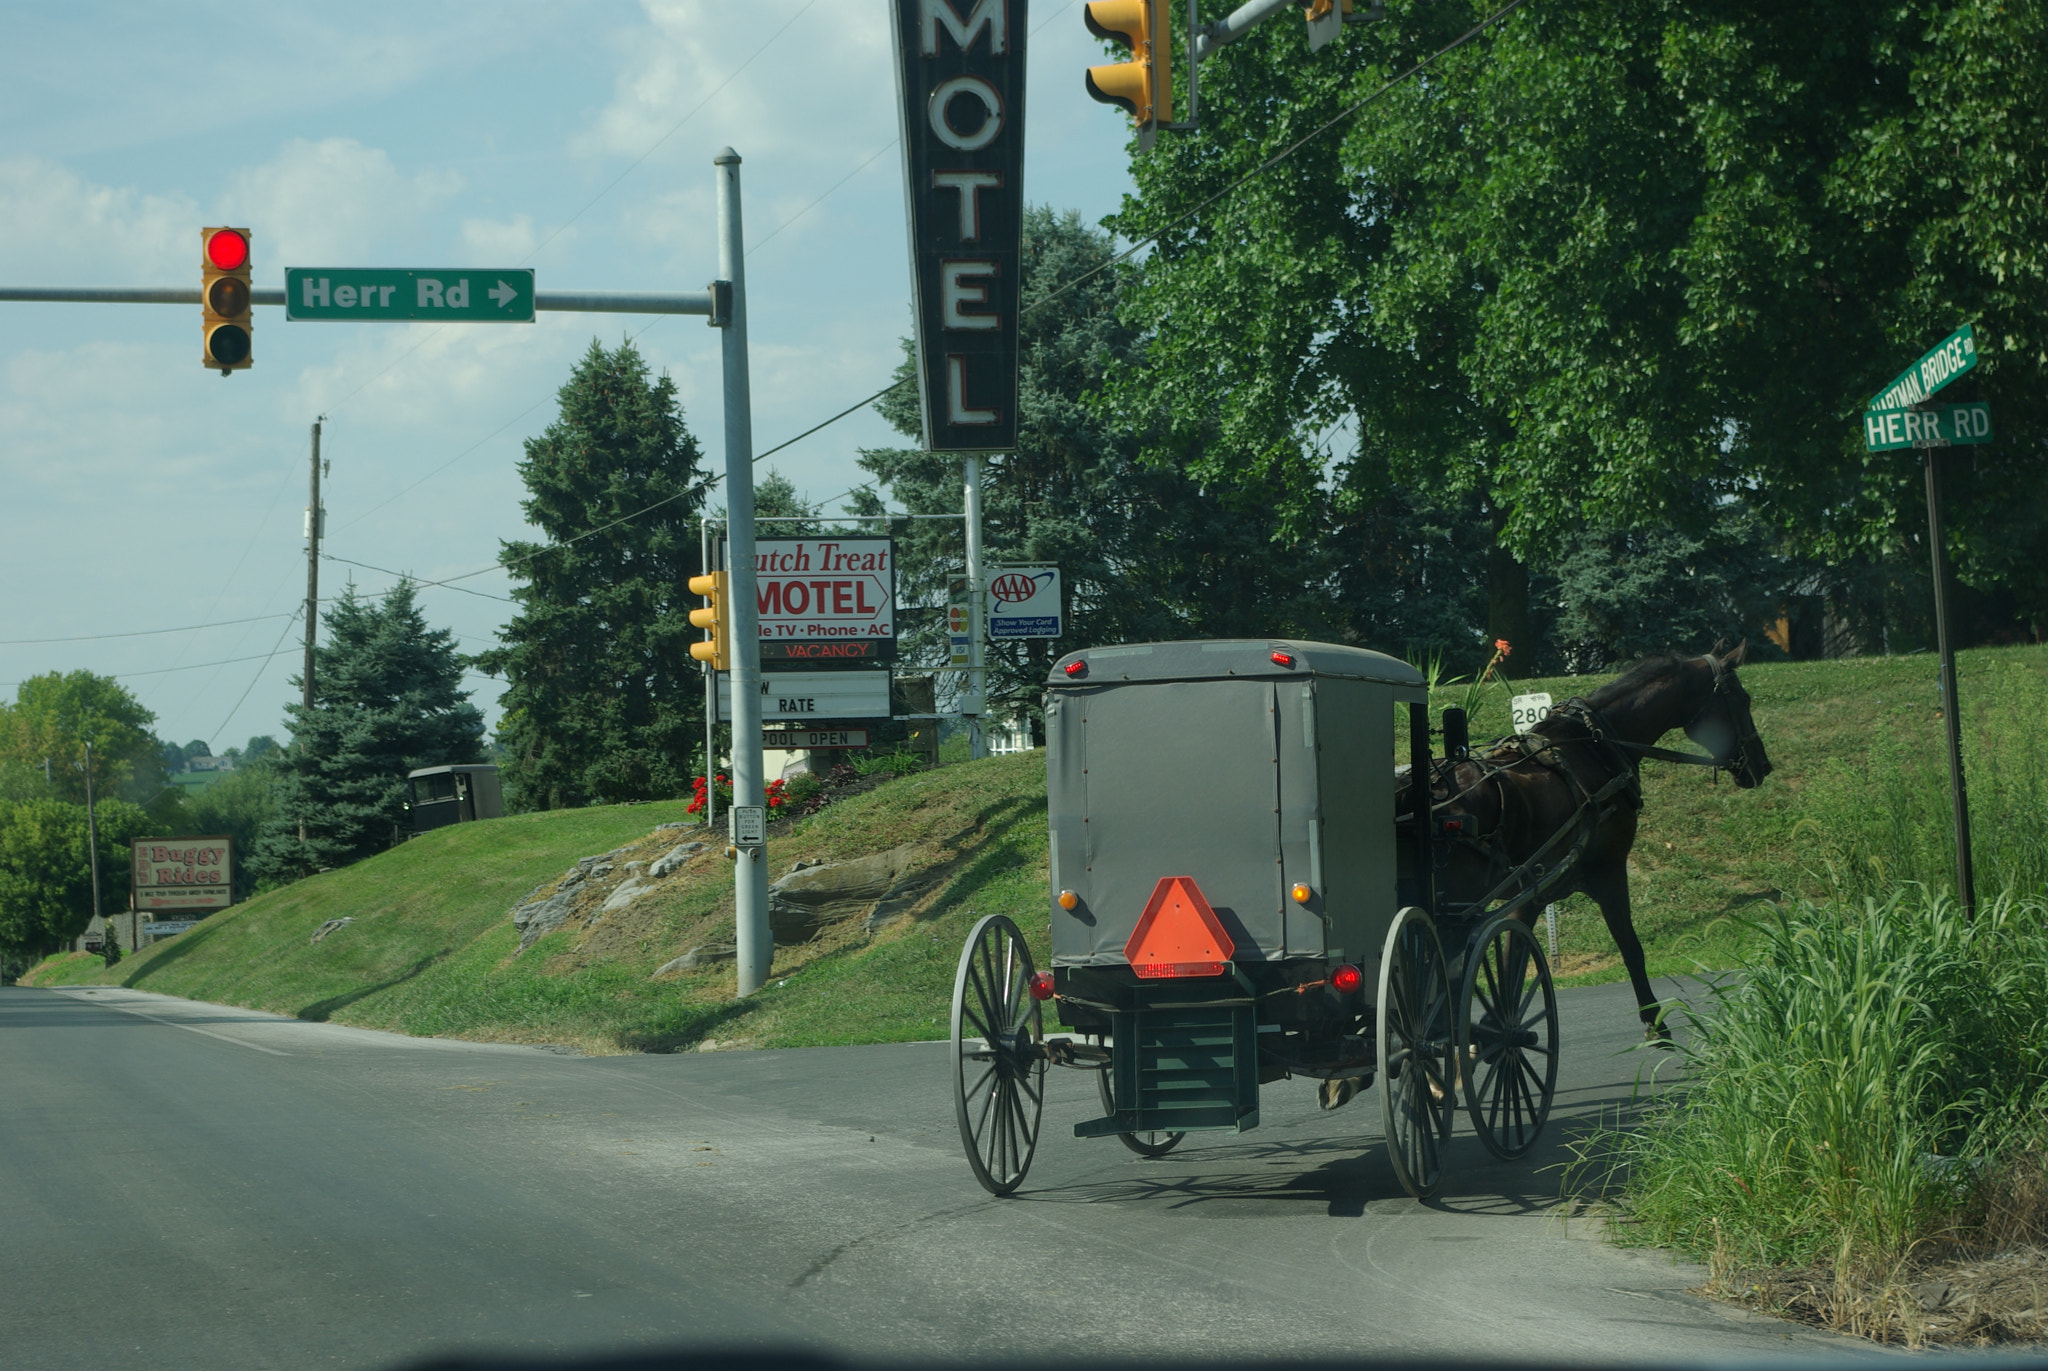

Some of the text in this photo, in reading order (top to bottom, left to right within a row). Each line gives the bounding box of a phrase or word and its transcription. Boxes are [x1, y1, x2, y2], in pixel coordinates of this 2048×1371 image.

[920, 0, 1009, 426] MOTEL
[302, 277, 469, 309] Herr Rd
[1920, 336, 1967, 393] BRIDGE
[1963, 337, 1974, 356] RD
[1866, 408, 1990, 446] HERR RD
[755, 543, 888, 572] utch Treat
[994, 574, 1033, 602] AAA
[757, 581, 875, 615] MOTEL
[775, 624, 797, 637] TV
[807, 624, 858, 636] Phone
[867, 623, 890, 636] AC
[993, 626, 1058, 635] Approved Lodging
[1036, 618, 1053, 626] Card
[785, 643, 869, 658] VACANCY
[779, 698, 815, 713] RATE
[1513, 706, 1548, 724] 280
[809, 732, 849, 746] OPEN
[152, 846, 225, 866] Buggy
[156, 866, 221, 884] Rides
